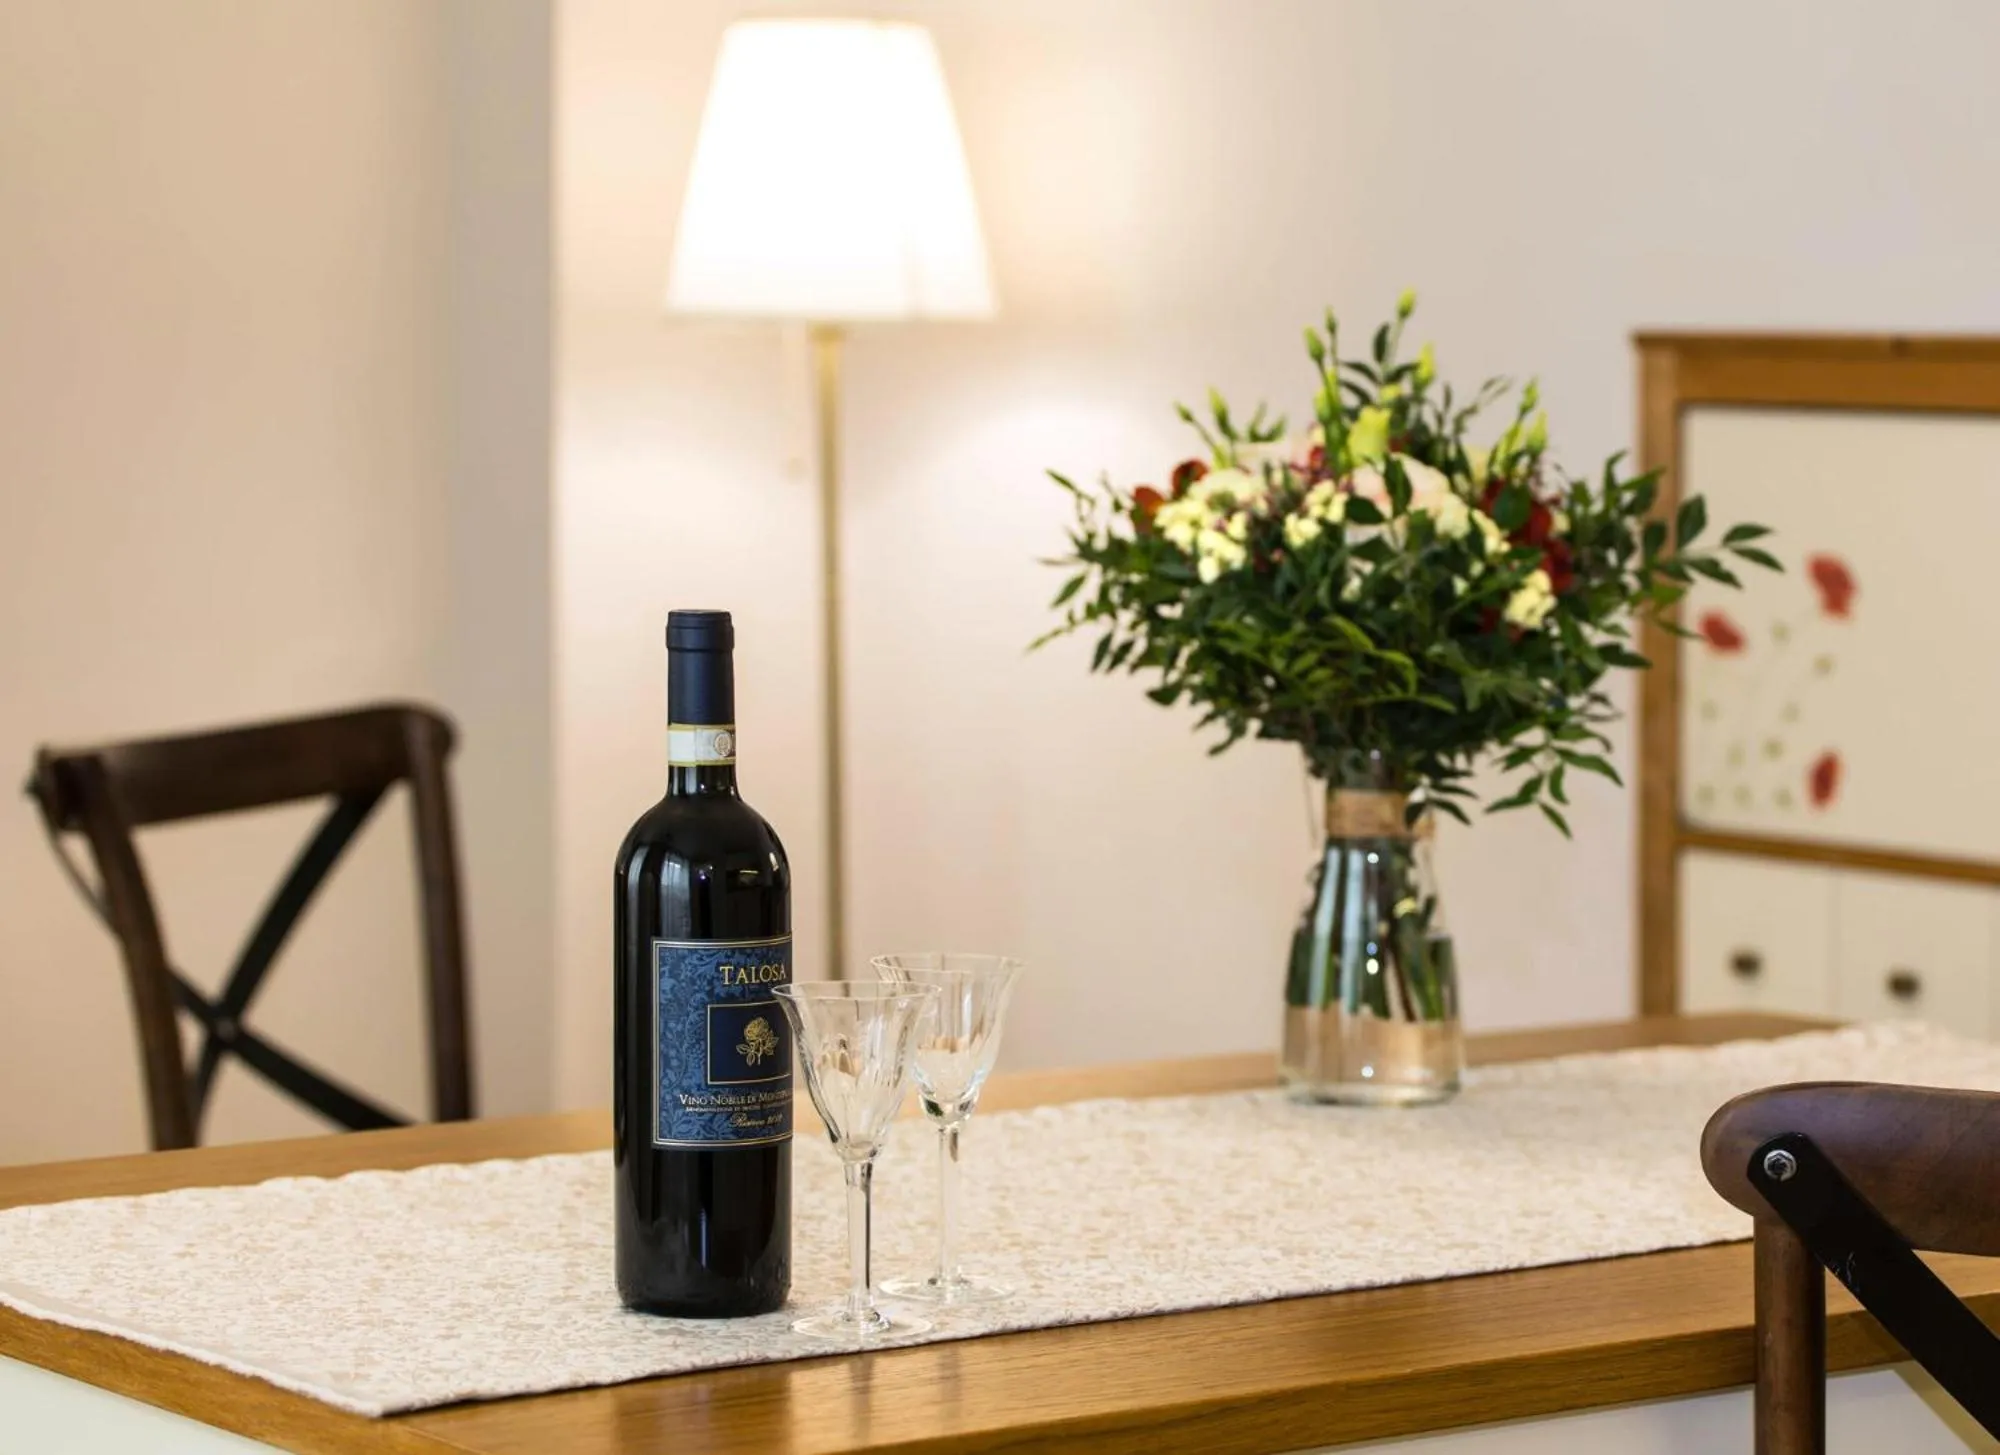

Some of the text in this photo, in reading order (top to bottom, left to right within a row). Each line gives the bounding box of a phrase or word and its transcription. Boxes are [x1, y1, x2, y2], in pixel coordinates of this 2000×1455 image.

[719, 963, 786, 985] TALOSA
[679, 1094, 708, 1105] VINO
[710, 1094, 746, 1105] NOBILE
